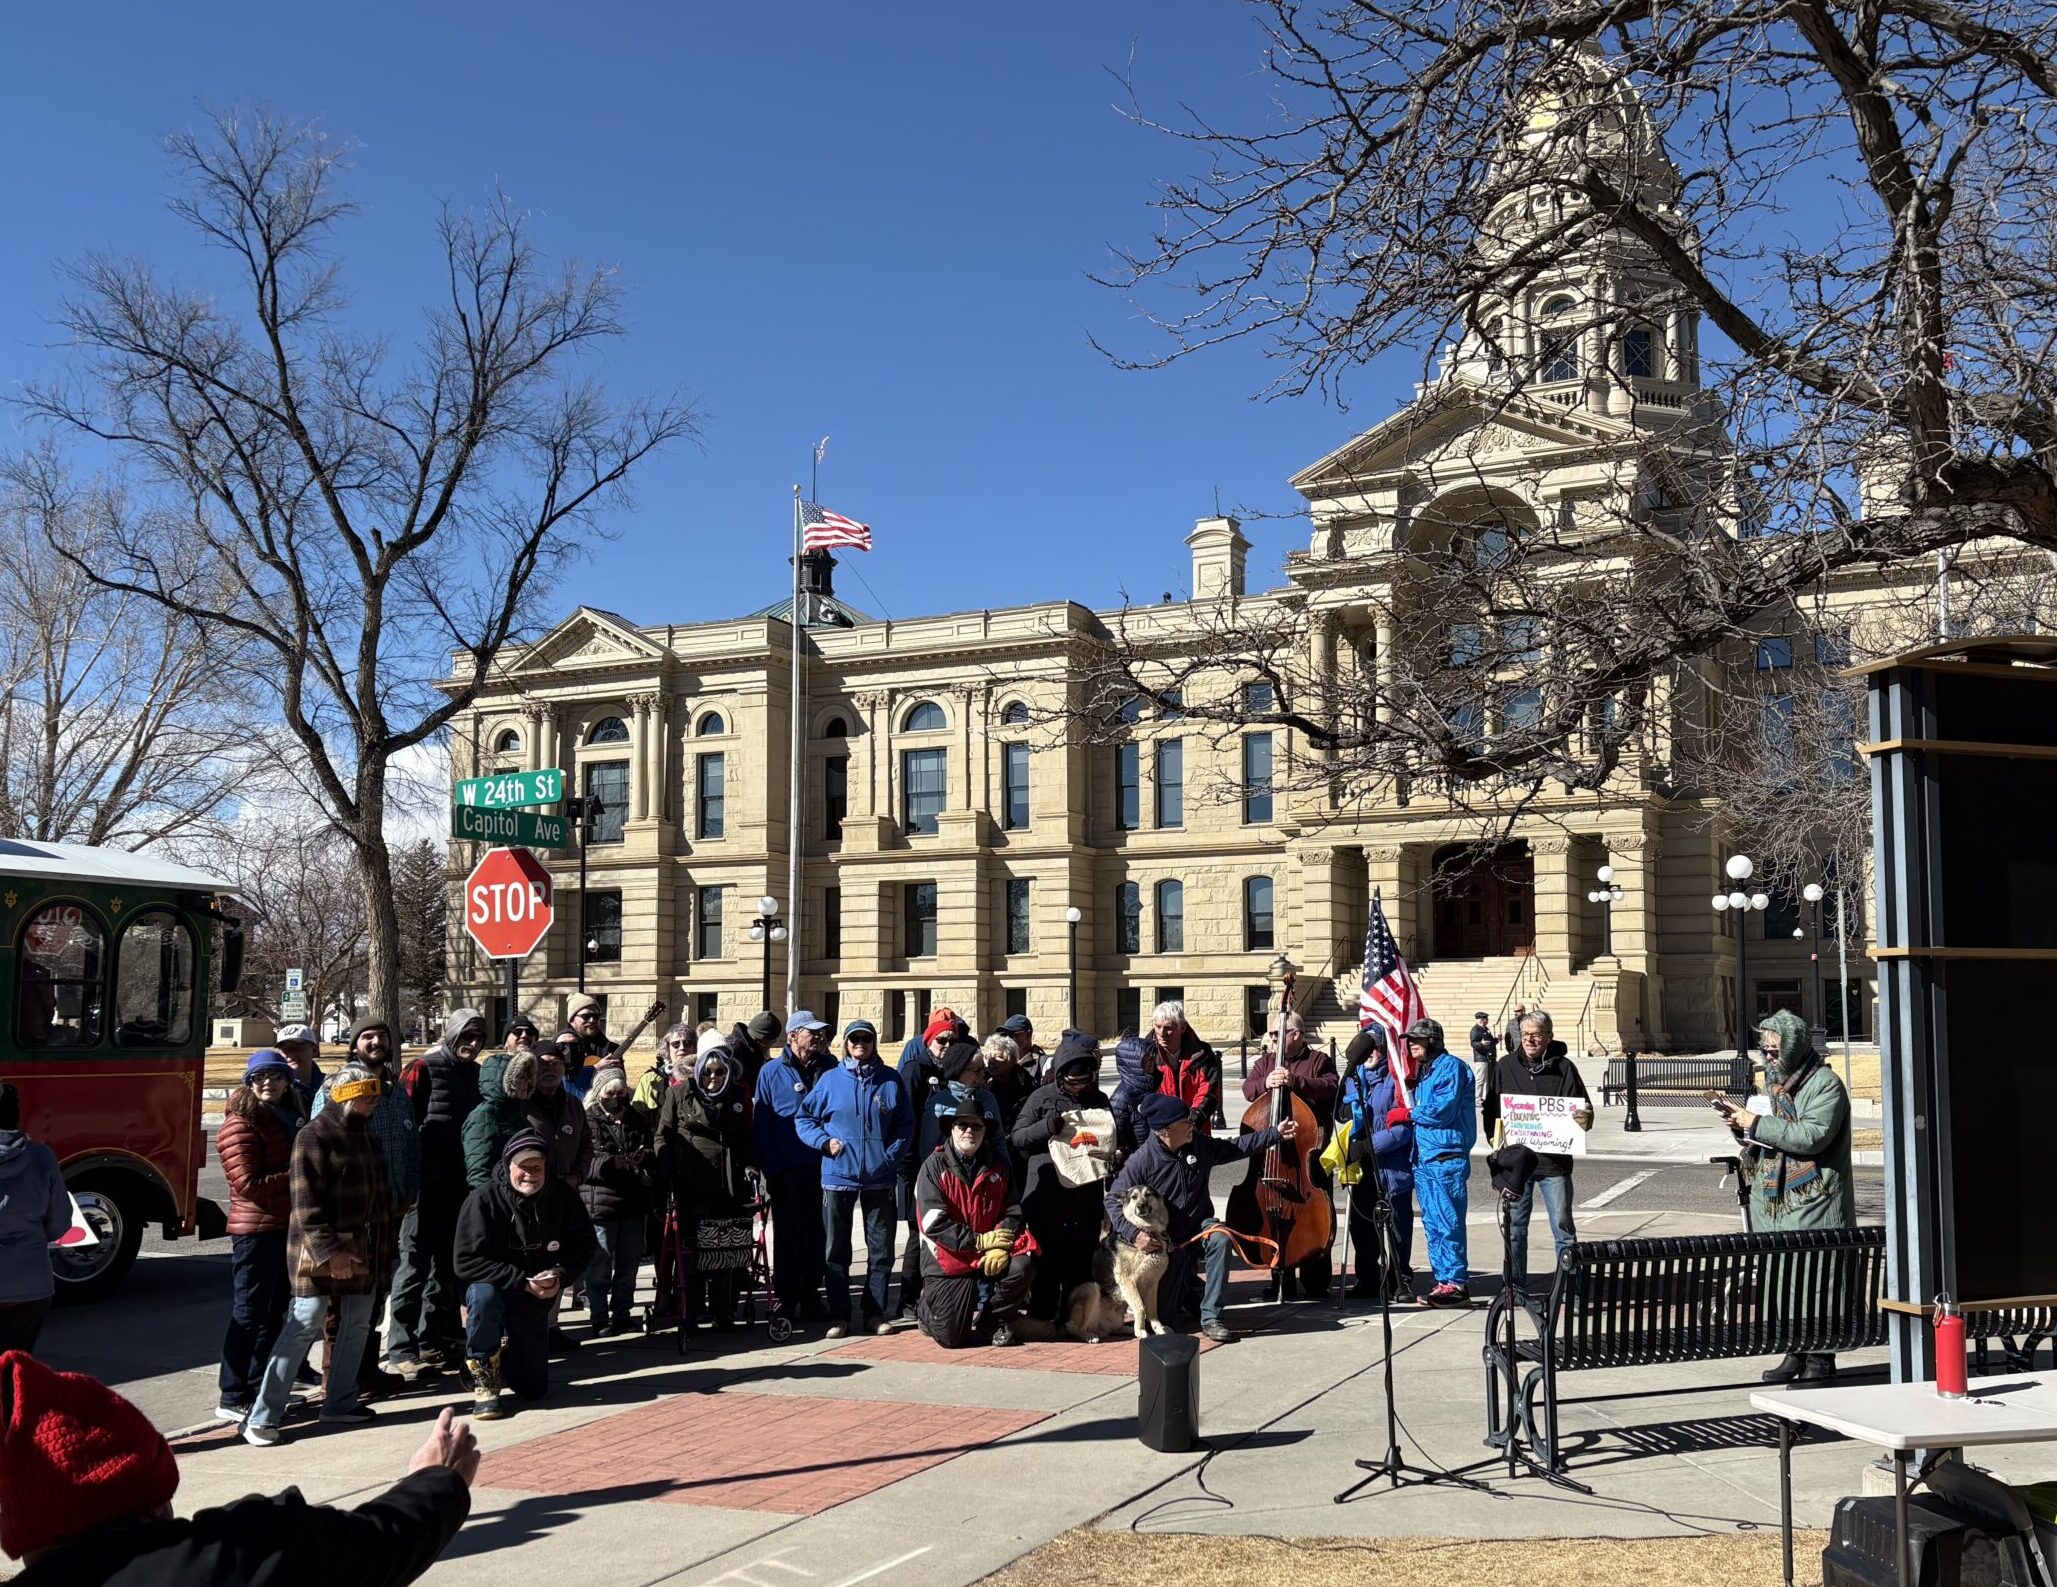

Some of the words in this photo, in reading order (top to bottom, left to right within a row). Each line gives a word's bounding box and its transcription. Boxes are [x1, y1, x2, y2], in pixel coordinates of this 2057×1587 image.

[463, 783, 476, 805] W
[484, 778, 525, 805] 24th
[535, 774, 554, 799] St
[463, 807, 518, 839] Capitol
[535, 816, 560, 842] Ave
[471, 881, 546, 924] STOP
[1539, 1097, 1565, 1112] PBS
[1530, 1137, 1574, 1152] Wyoming!
